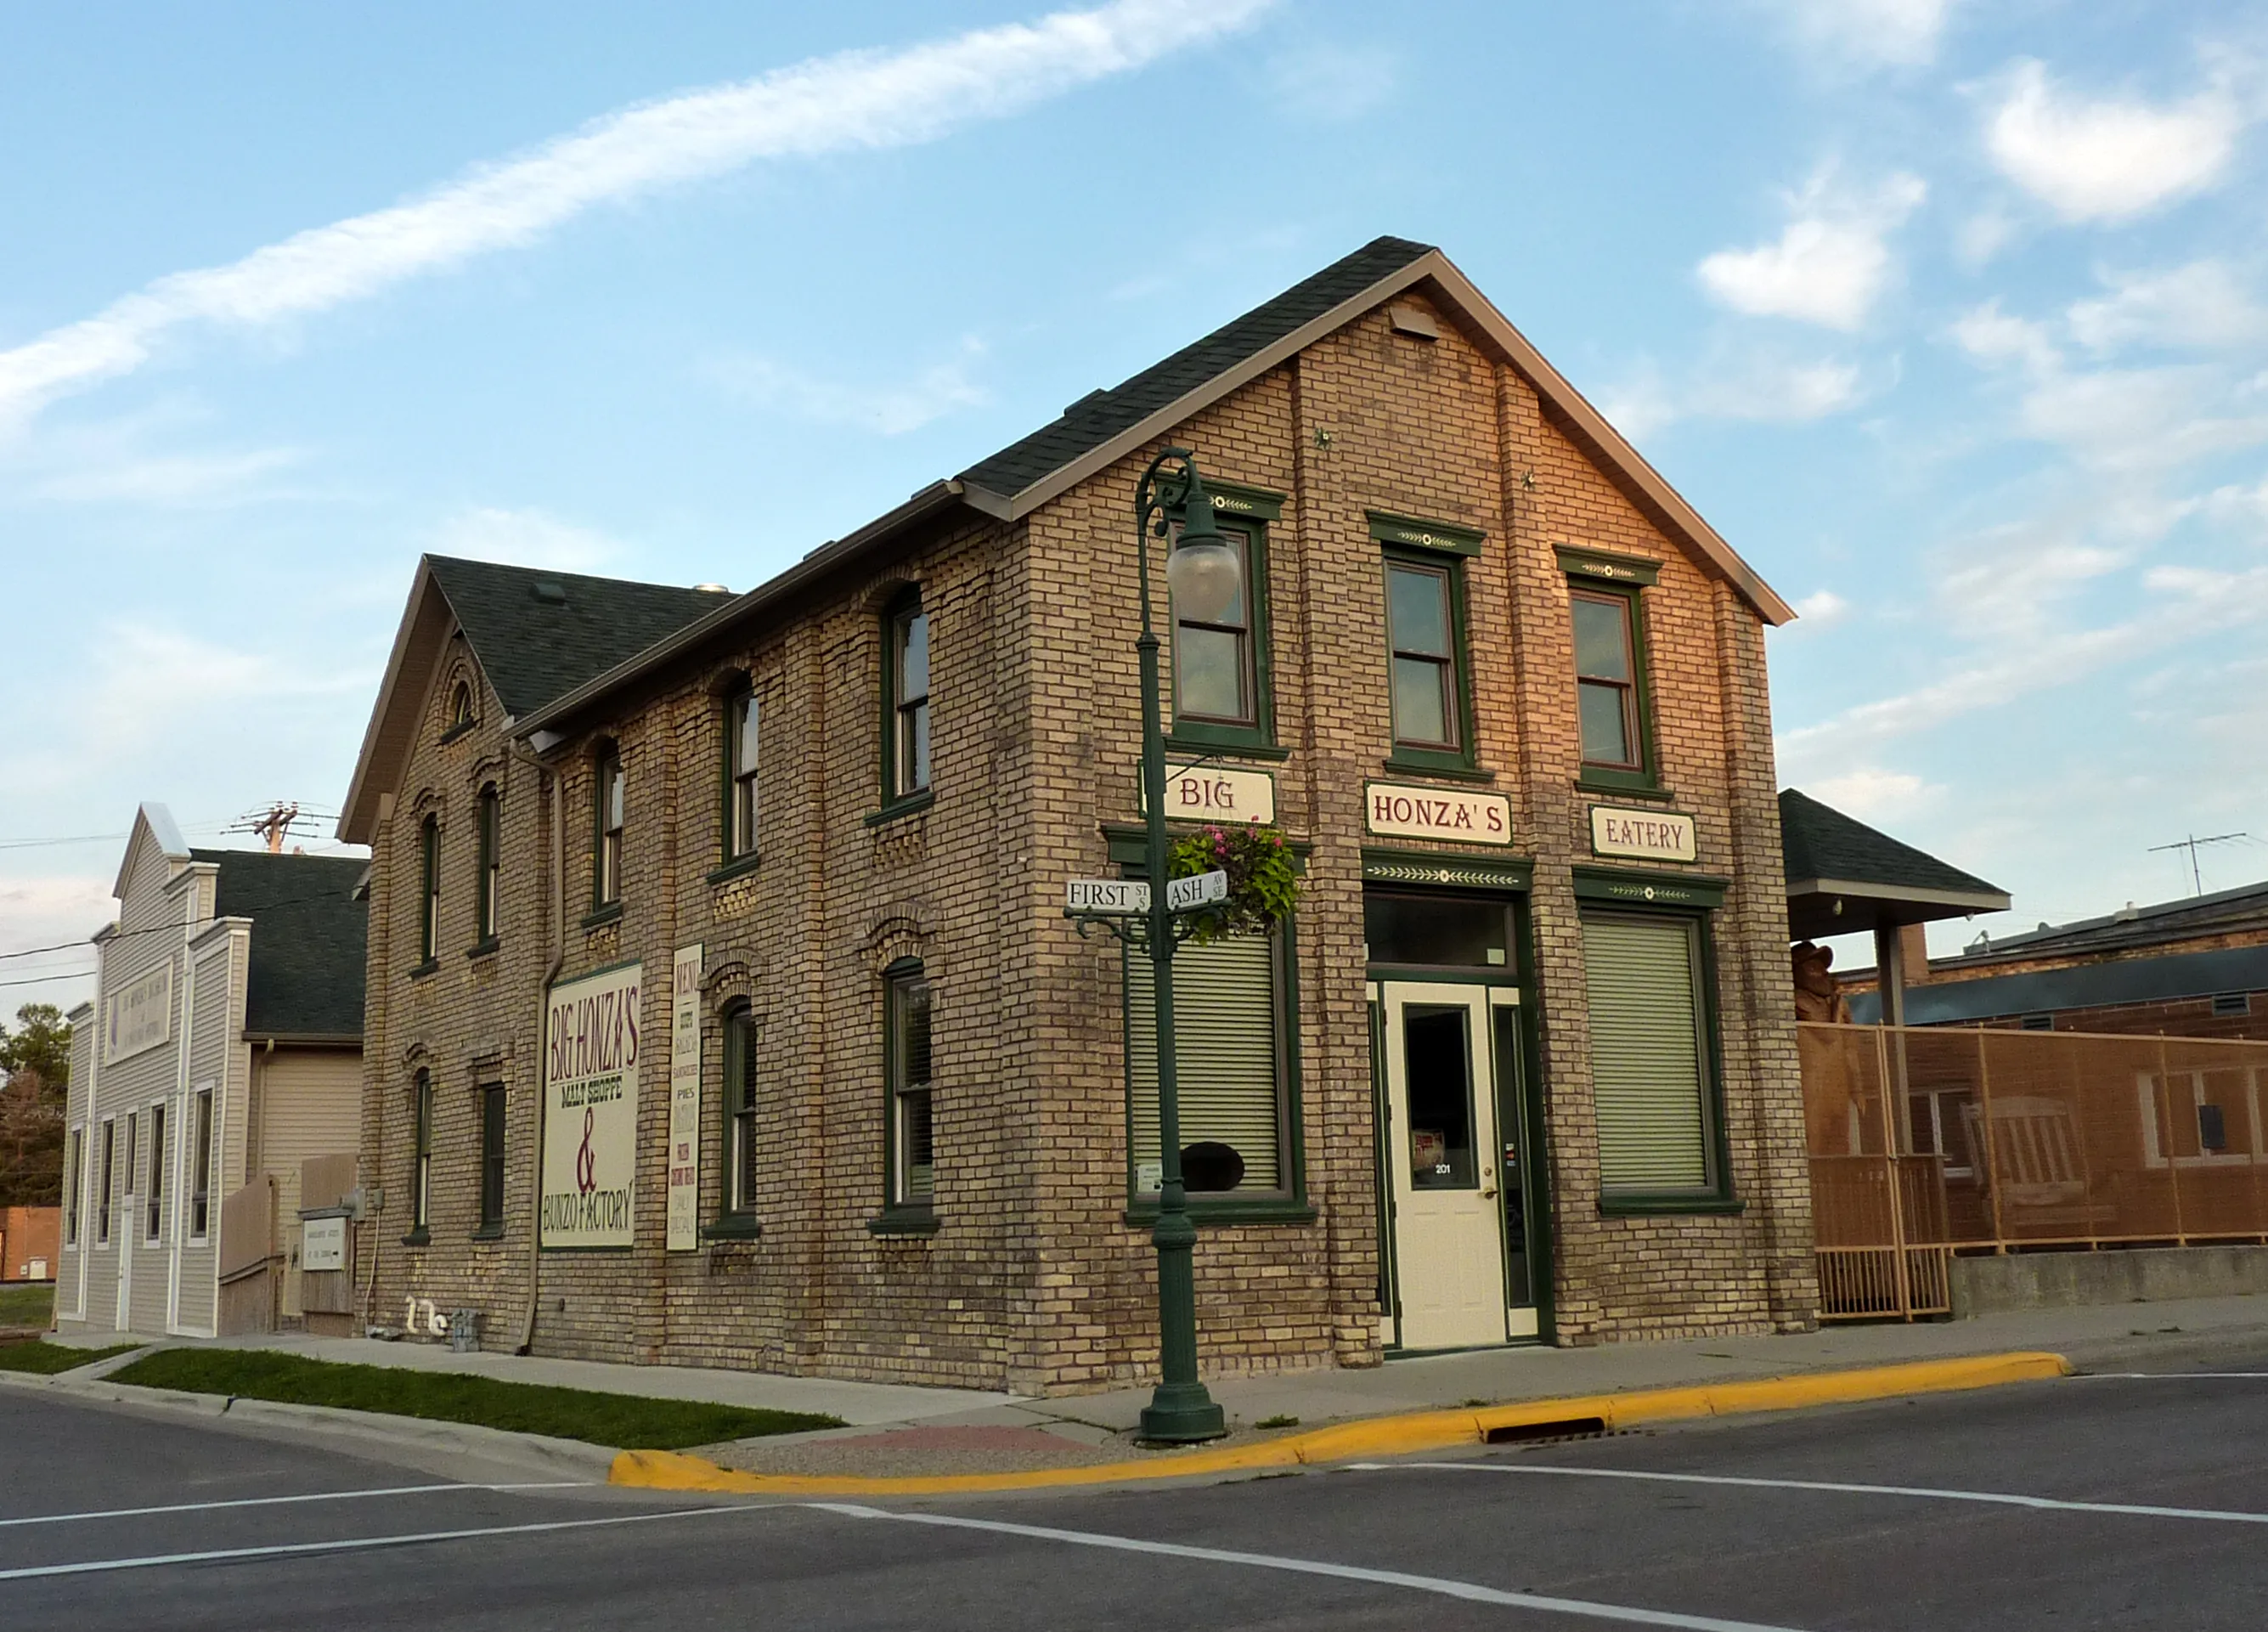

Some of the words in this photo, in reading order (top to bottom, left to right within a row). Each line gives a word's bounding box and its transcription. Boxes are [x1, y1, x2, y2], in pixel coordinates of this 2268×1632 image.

[1180, 777, 1234, 809] BIG
[1374, 794, 1504, 833] HONZA'S
[1605, 817, 1684, 850] EATERY
[1069, 883, 1129, 906] FIRST
[1135, 886, 1148, 895] ST
[1138, 897, 1146, 908] S
[1170, 878, 1204, 906] ASH
[1212, 874, 1224, 887] AV
[1212, 886, 1224, 898] SE
[551, 1004, 573, 1082] BIG
[576, 985, 639, 1076] HONZA'S
[561, 1081, 586, 1110] MALT
[587, 1075, 623, 1108] SHOPPE
[676, 1087, 695, 1099] PIES
[576, 1106, 596, 1194] &
[1436, 1164, 1450, 1174] 201
[543, 1192, 578, 1234] BUNZO
[579, 1178, 633, 1231] FACTORY
